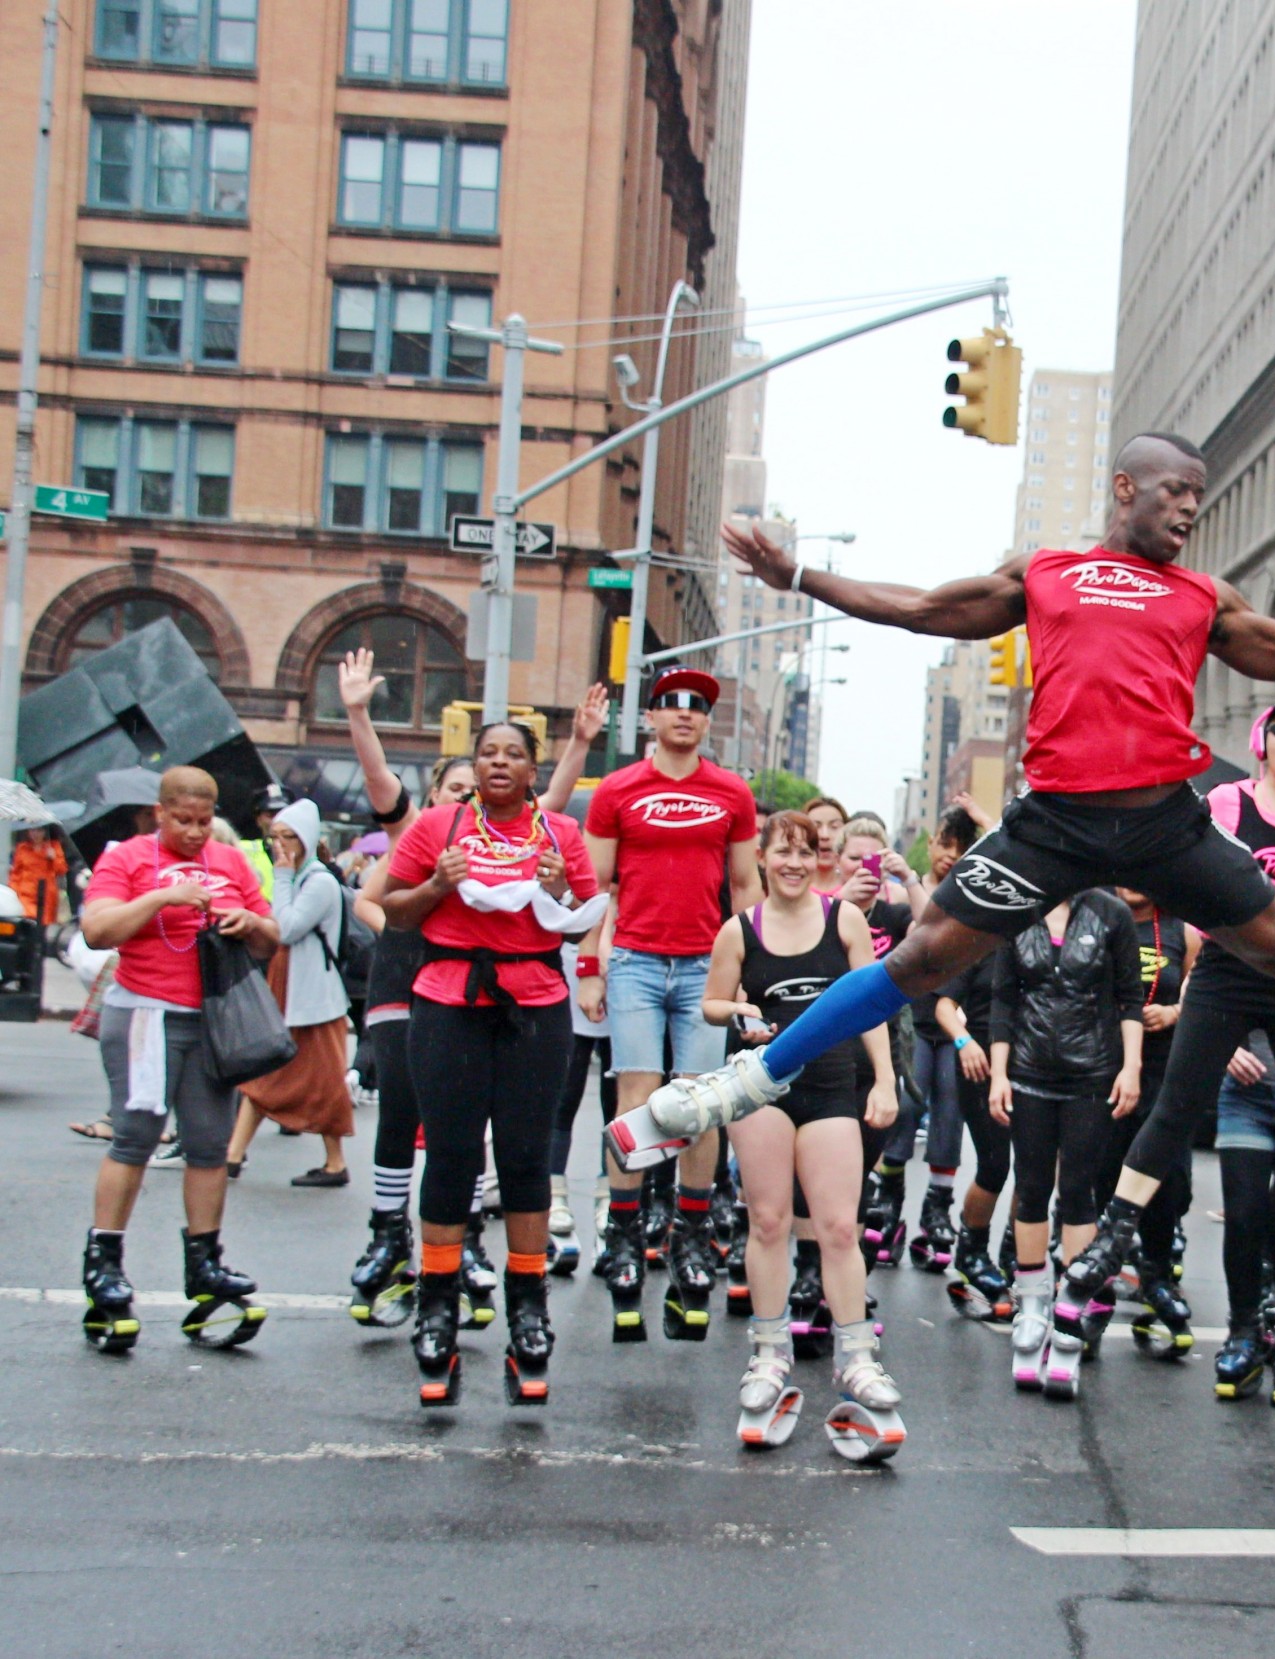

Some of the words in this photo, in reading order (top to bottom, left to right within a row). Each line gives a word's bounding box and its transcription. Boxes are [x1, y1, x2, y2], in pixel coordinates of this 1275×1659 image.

[51, 490, 67, 512] 4
[73, 493, 92, 506] AV
[468, 527, 495, 543] ONE
